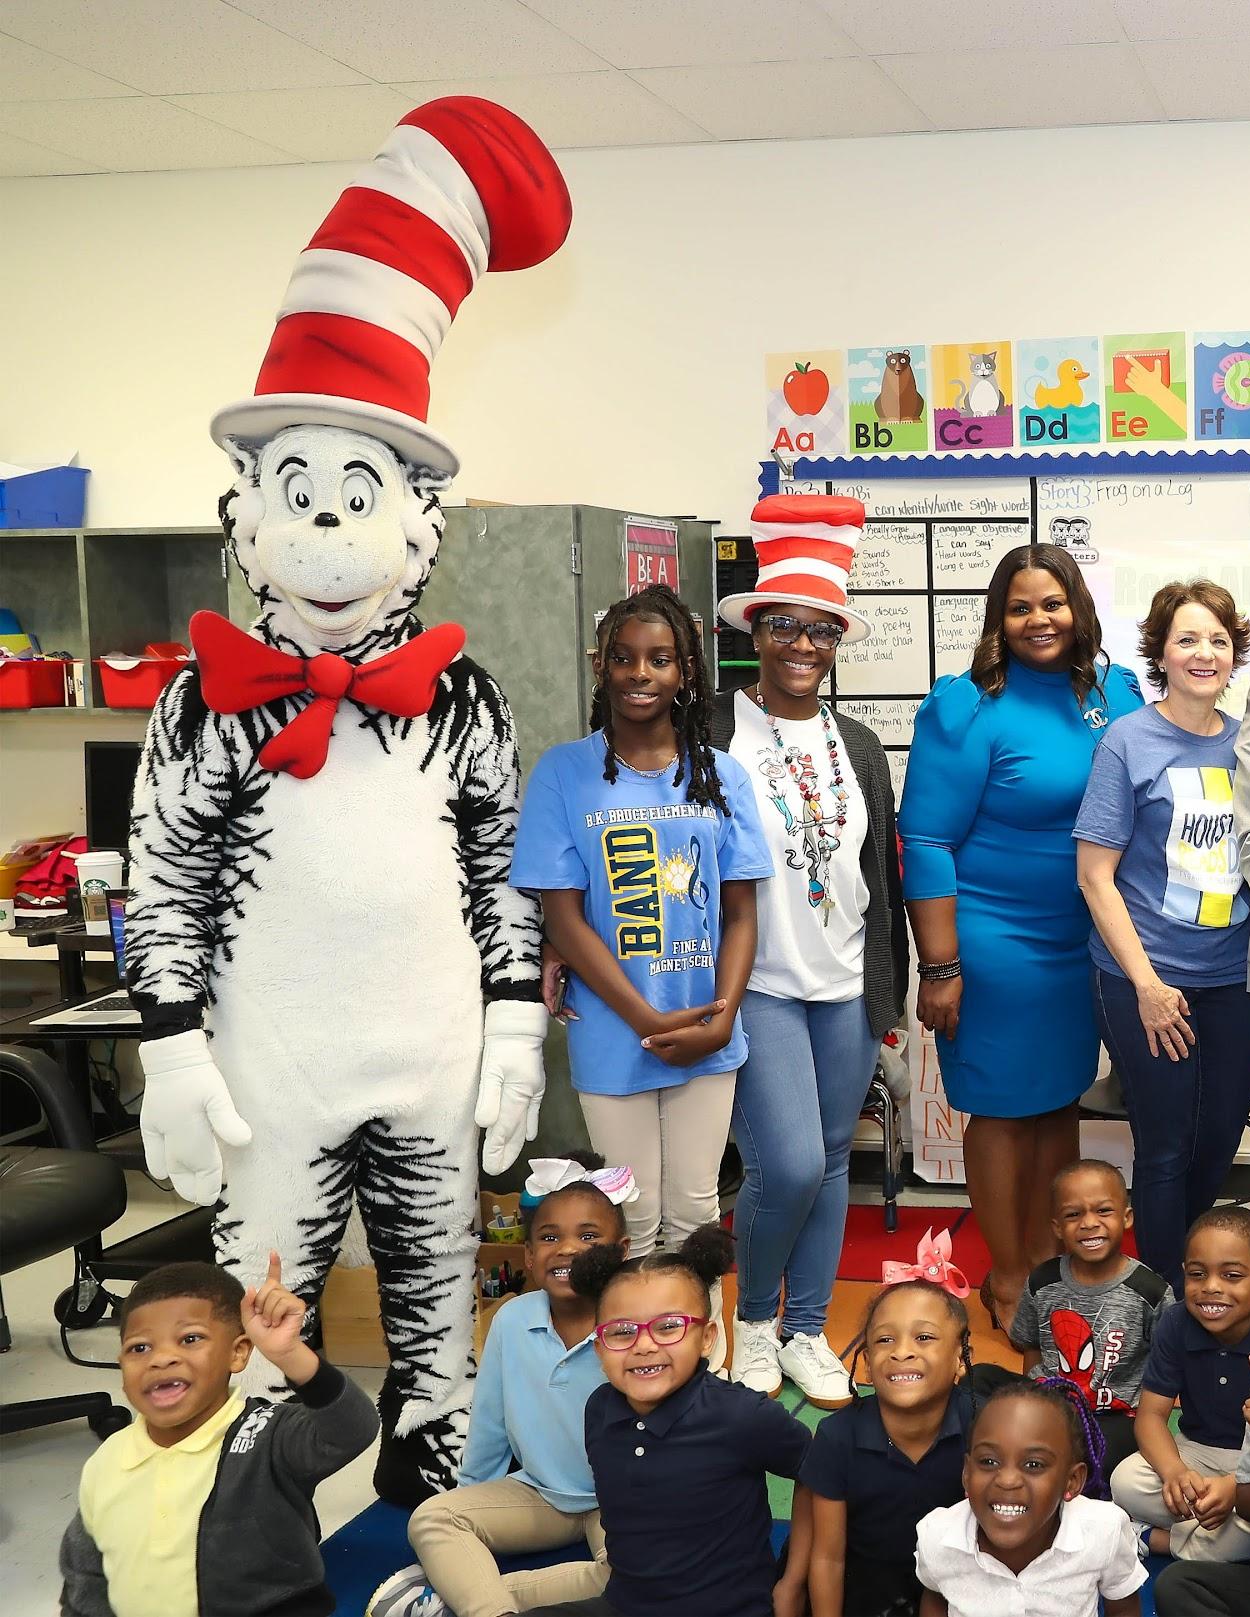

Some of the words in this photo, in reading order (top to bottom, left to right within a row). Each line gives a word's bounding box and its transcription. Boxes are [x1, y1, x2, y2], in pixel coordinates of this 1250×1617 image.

[939, 419, 983, 446] Cc
[1026, 413, 1068, 441] Dd
[1111, 411, 1148, 437] Ee
[1200, 408, 1224, 436] Ff
[773, 427, 815, 453] Aa
[855, 422, 893, 449] Bb
[1096, 480, 1128, 506] Frog
[1132, 485, 1151, 498] on
[1155, 484, 1163, 496] a
[1166, 479, 1193, 505] Log
[933, 525, 977, 536] Language
[638, 554, 653, 583] BE
[658, 557, 668, 583] A
[875, 606, 909, 616] discuss
[934, 596, 979, 611] Language
[883, 620, 911, 635] poetry
[935, 611, 945, 623] I
[951, 613, 967, 623] can
[874, 649, 894, 661] aloud
[838, 702, 881, 715] Students
[886, 703, 904, 714] will
[585, 812, 608, 828] B.K.
[608, 807, 648, 823] BRUCE
[1180, 813, 1234, 850] HOUST
[601, 824, 664, 960] BAND
[673, 938, 697, 955] FINE
[649, 957, 687, 976] MAGNET
[688, 956, 714, 968] SCHO
